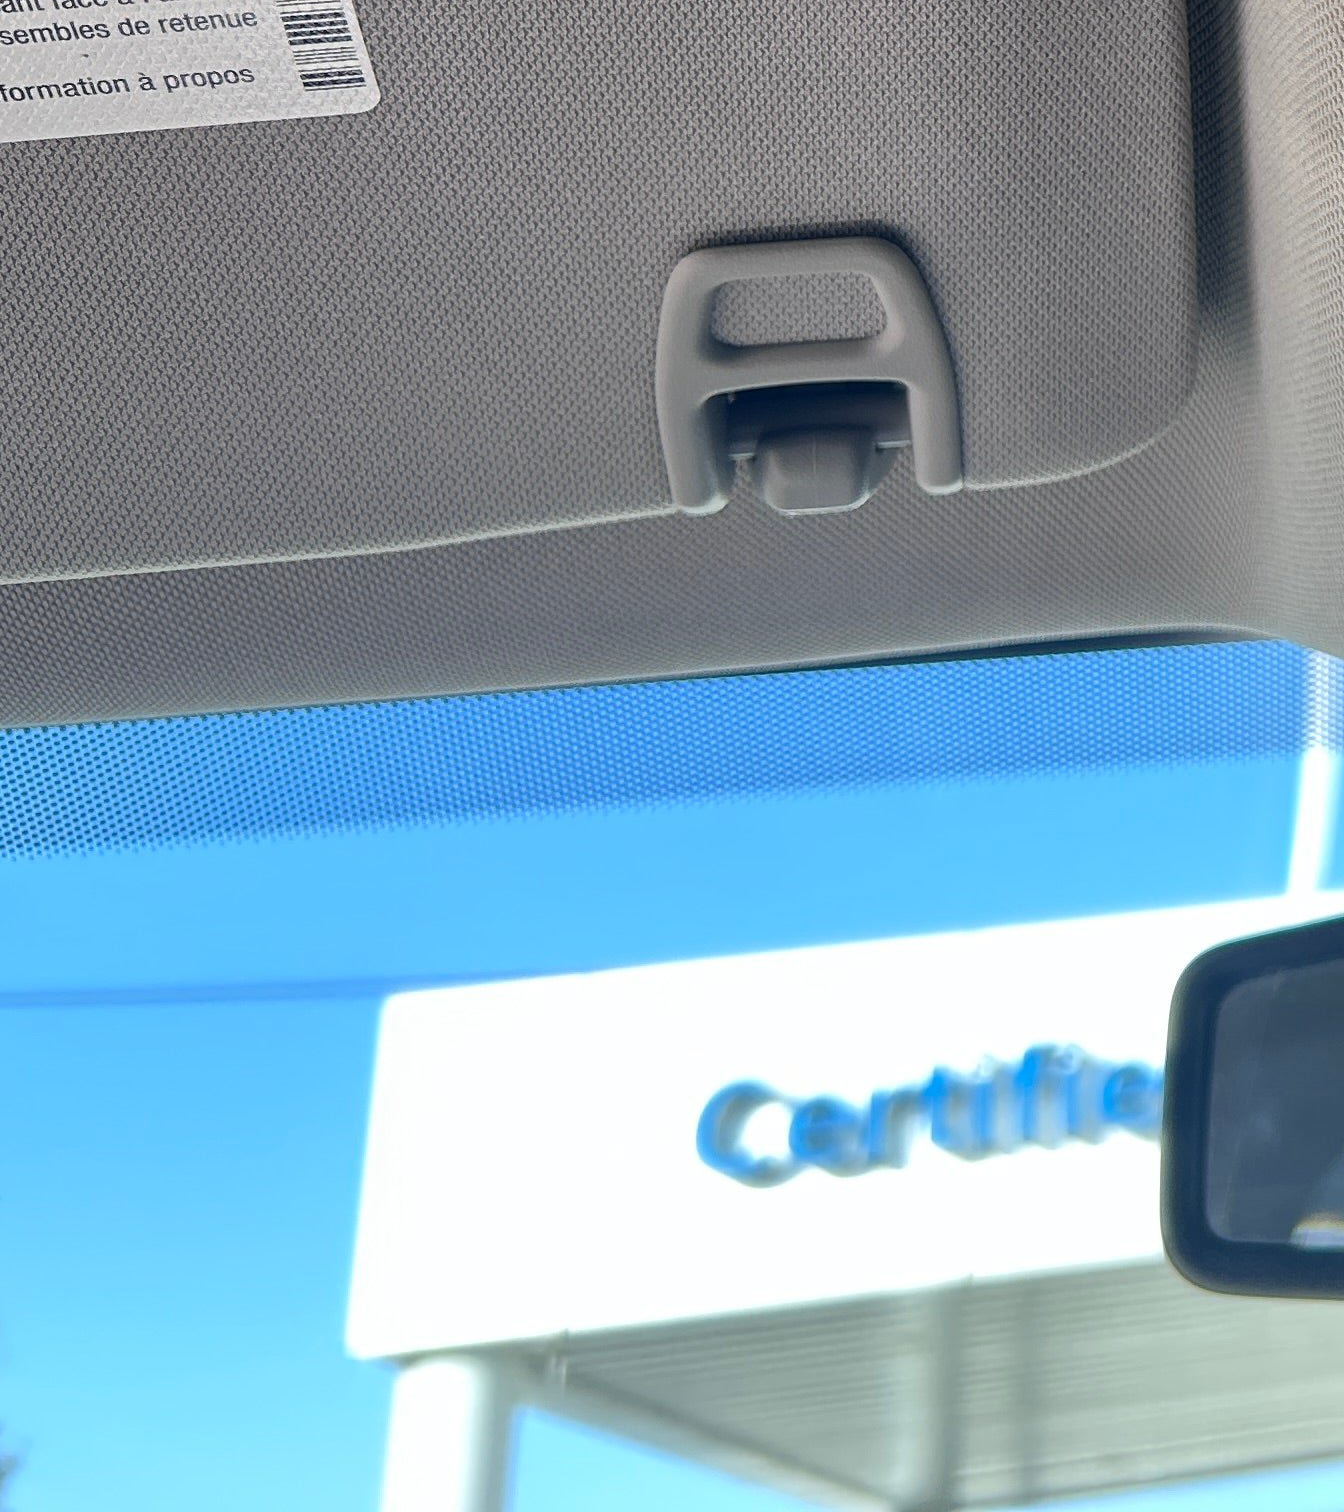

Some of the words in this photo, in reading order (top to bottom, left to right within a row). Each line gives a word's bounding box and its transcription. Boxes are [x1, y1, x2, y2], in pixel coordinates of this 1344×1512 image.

[117, 18, 151, 36] de
[157, 11, 257, 34] retenue
[138, 72, 157, 91] à
[162, 68, 255, 93] propos
[696, 1043, 1163, 1188] Certifie
